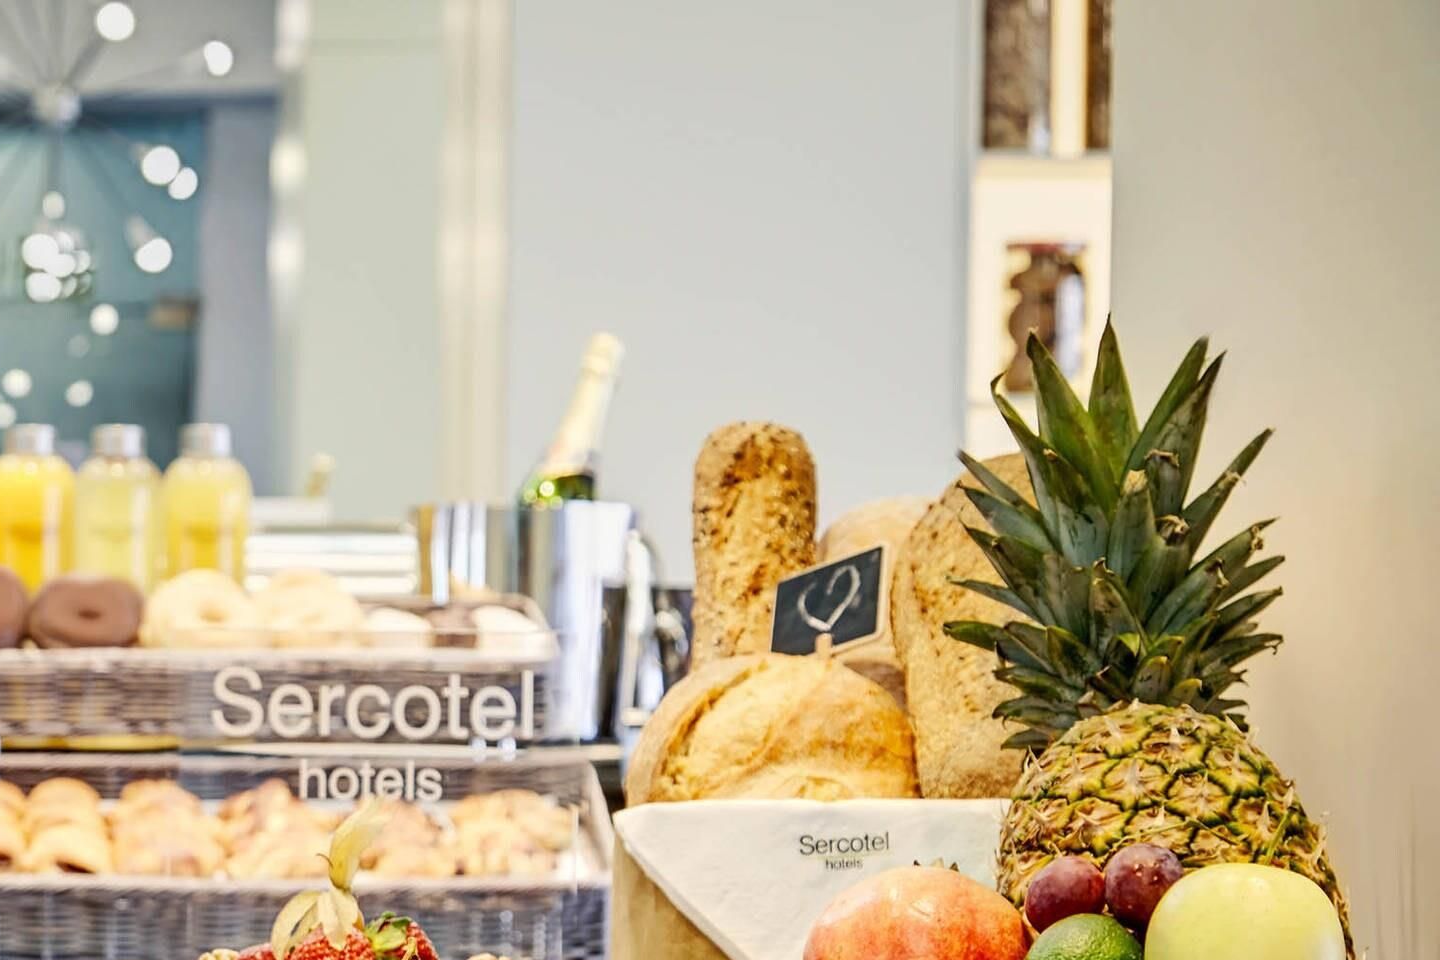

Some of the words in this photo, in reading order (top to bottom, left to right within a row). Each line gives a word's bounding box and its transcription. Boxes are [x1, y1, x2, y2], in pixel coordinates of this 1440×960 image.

[212, 667, 535, 741] Sercotel
[299, 758, 443, 802] hotels
[799, 832, 890, 856] Sercotel
[825, 857, 864, 870] hotels
